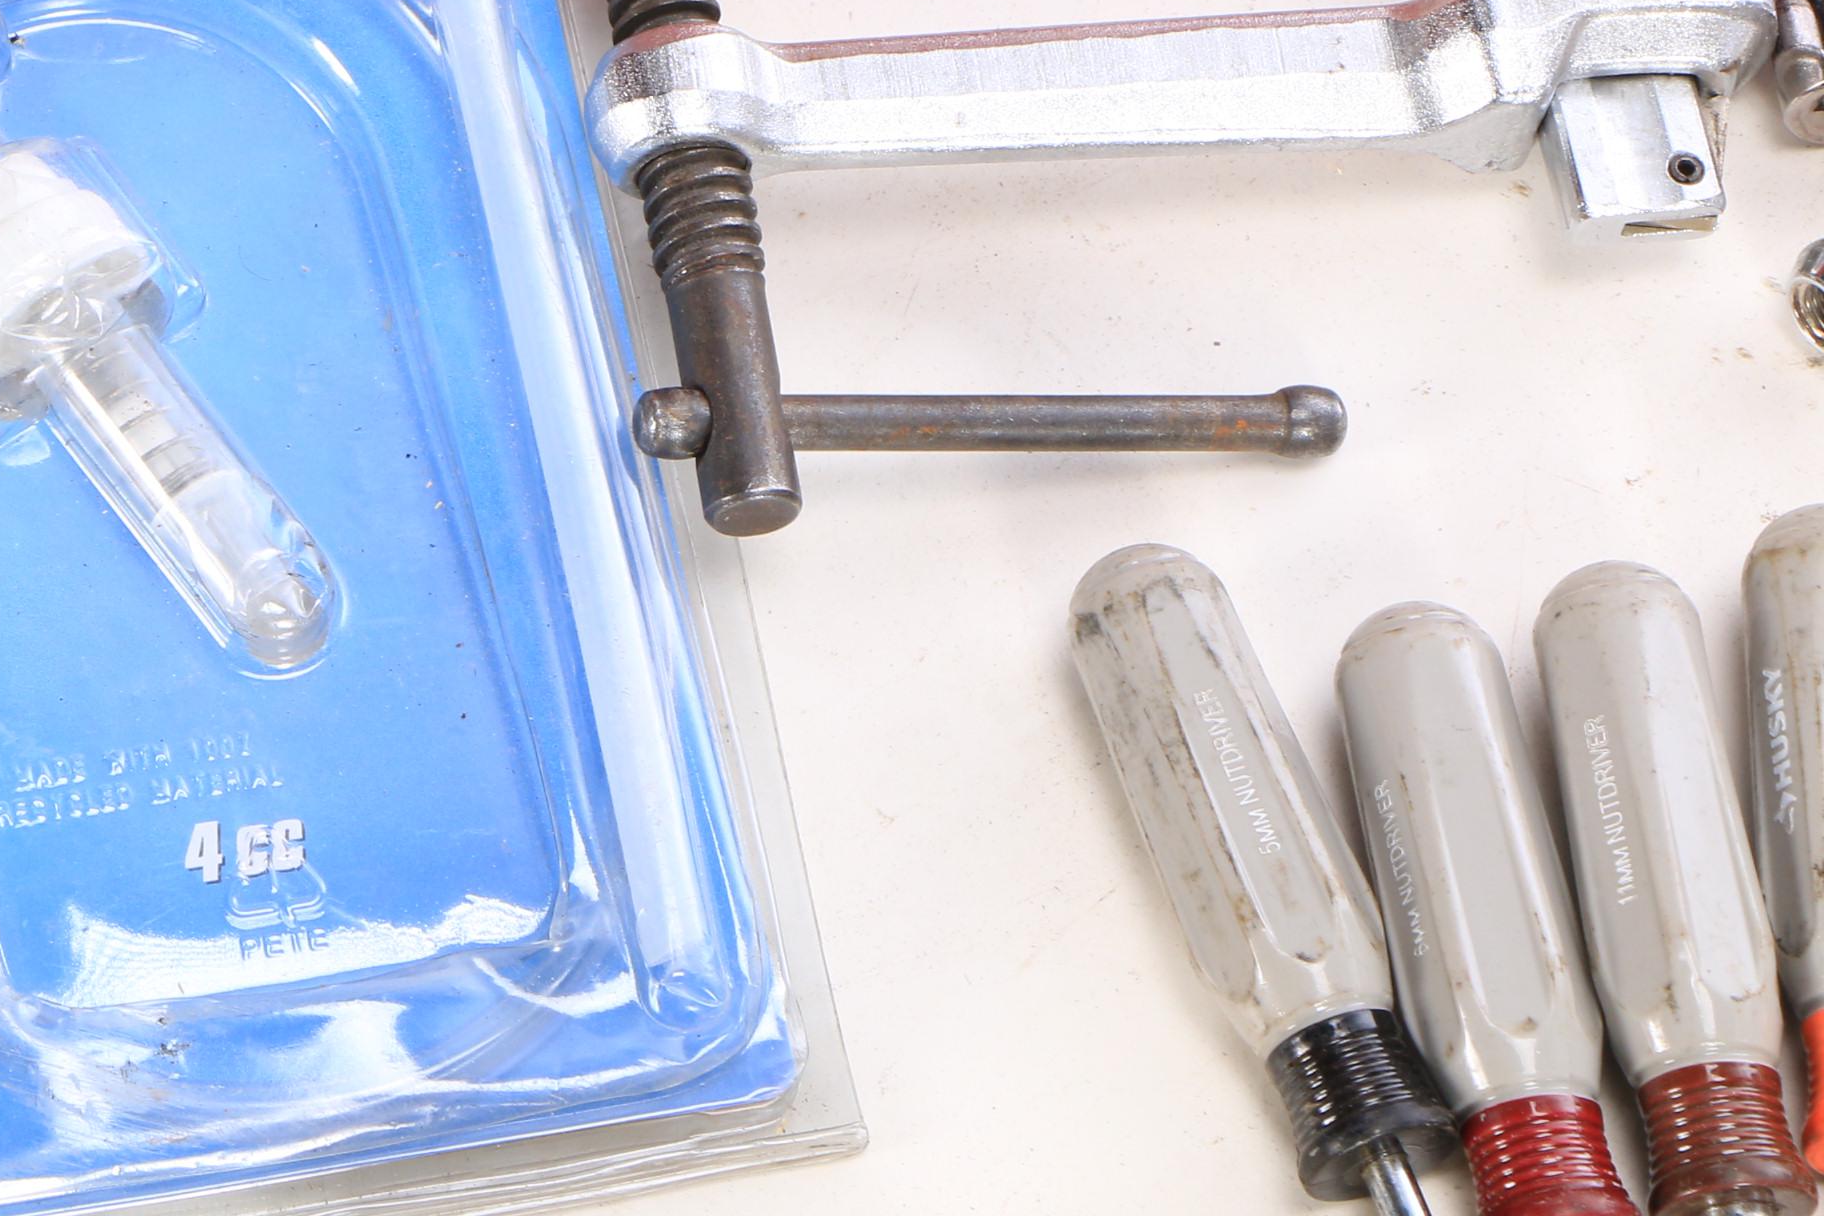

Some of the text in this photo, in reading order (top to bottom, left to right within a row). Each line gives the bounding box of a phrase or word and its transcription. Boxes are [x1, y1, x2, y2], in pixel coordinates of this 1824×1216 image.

[1193, 688, 1281, 856] 5MM NUTDRIVER
[1762, 668, 1793, 792] HUSKY
[184, 820, 225, 885] 4
[1374, 779, 1415, 907] NUTDRIVER
[1583, 714, 1638, 906] 11MM NUTDRIVER
[239, 927, 329, 961] PETE
